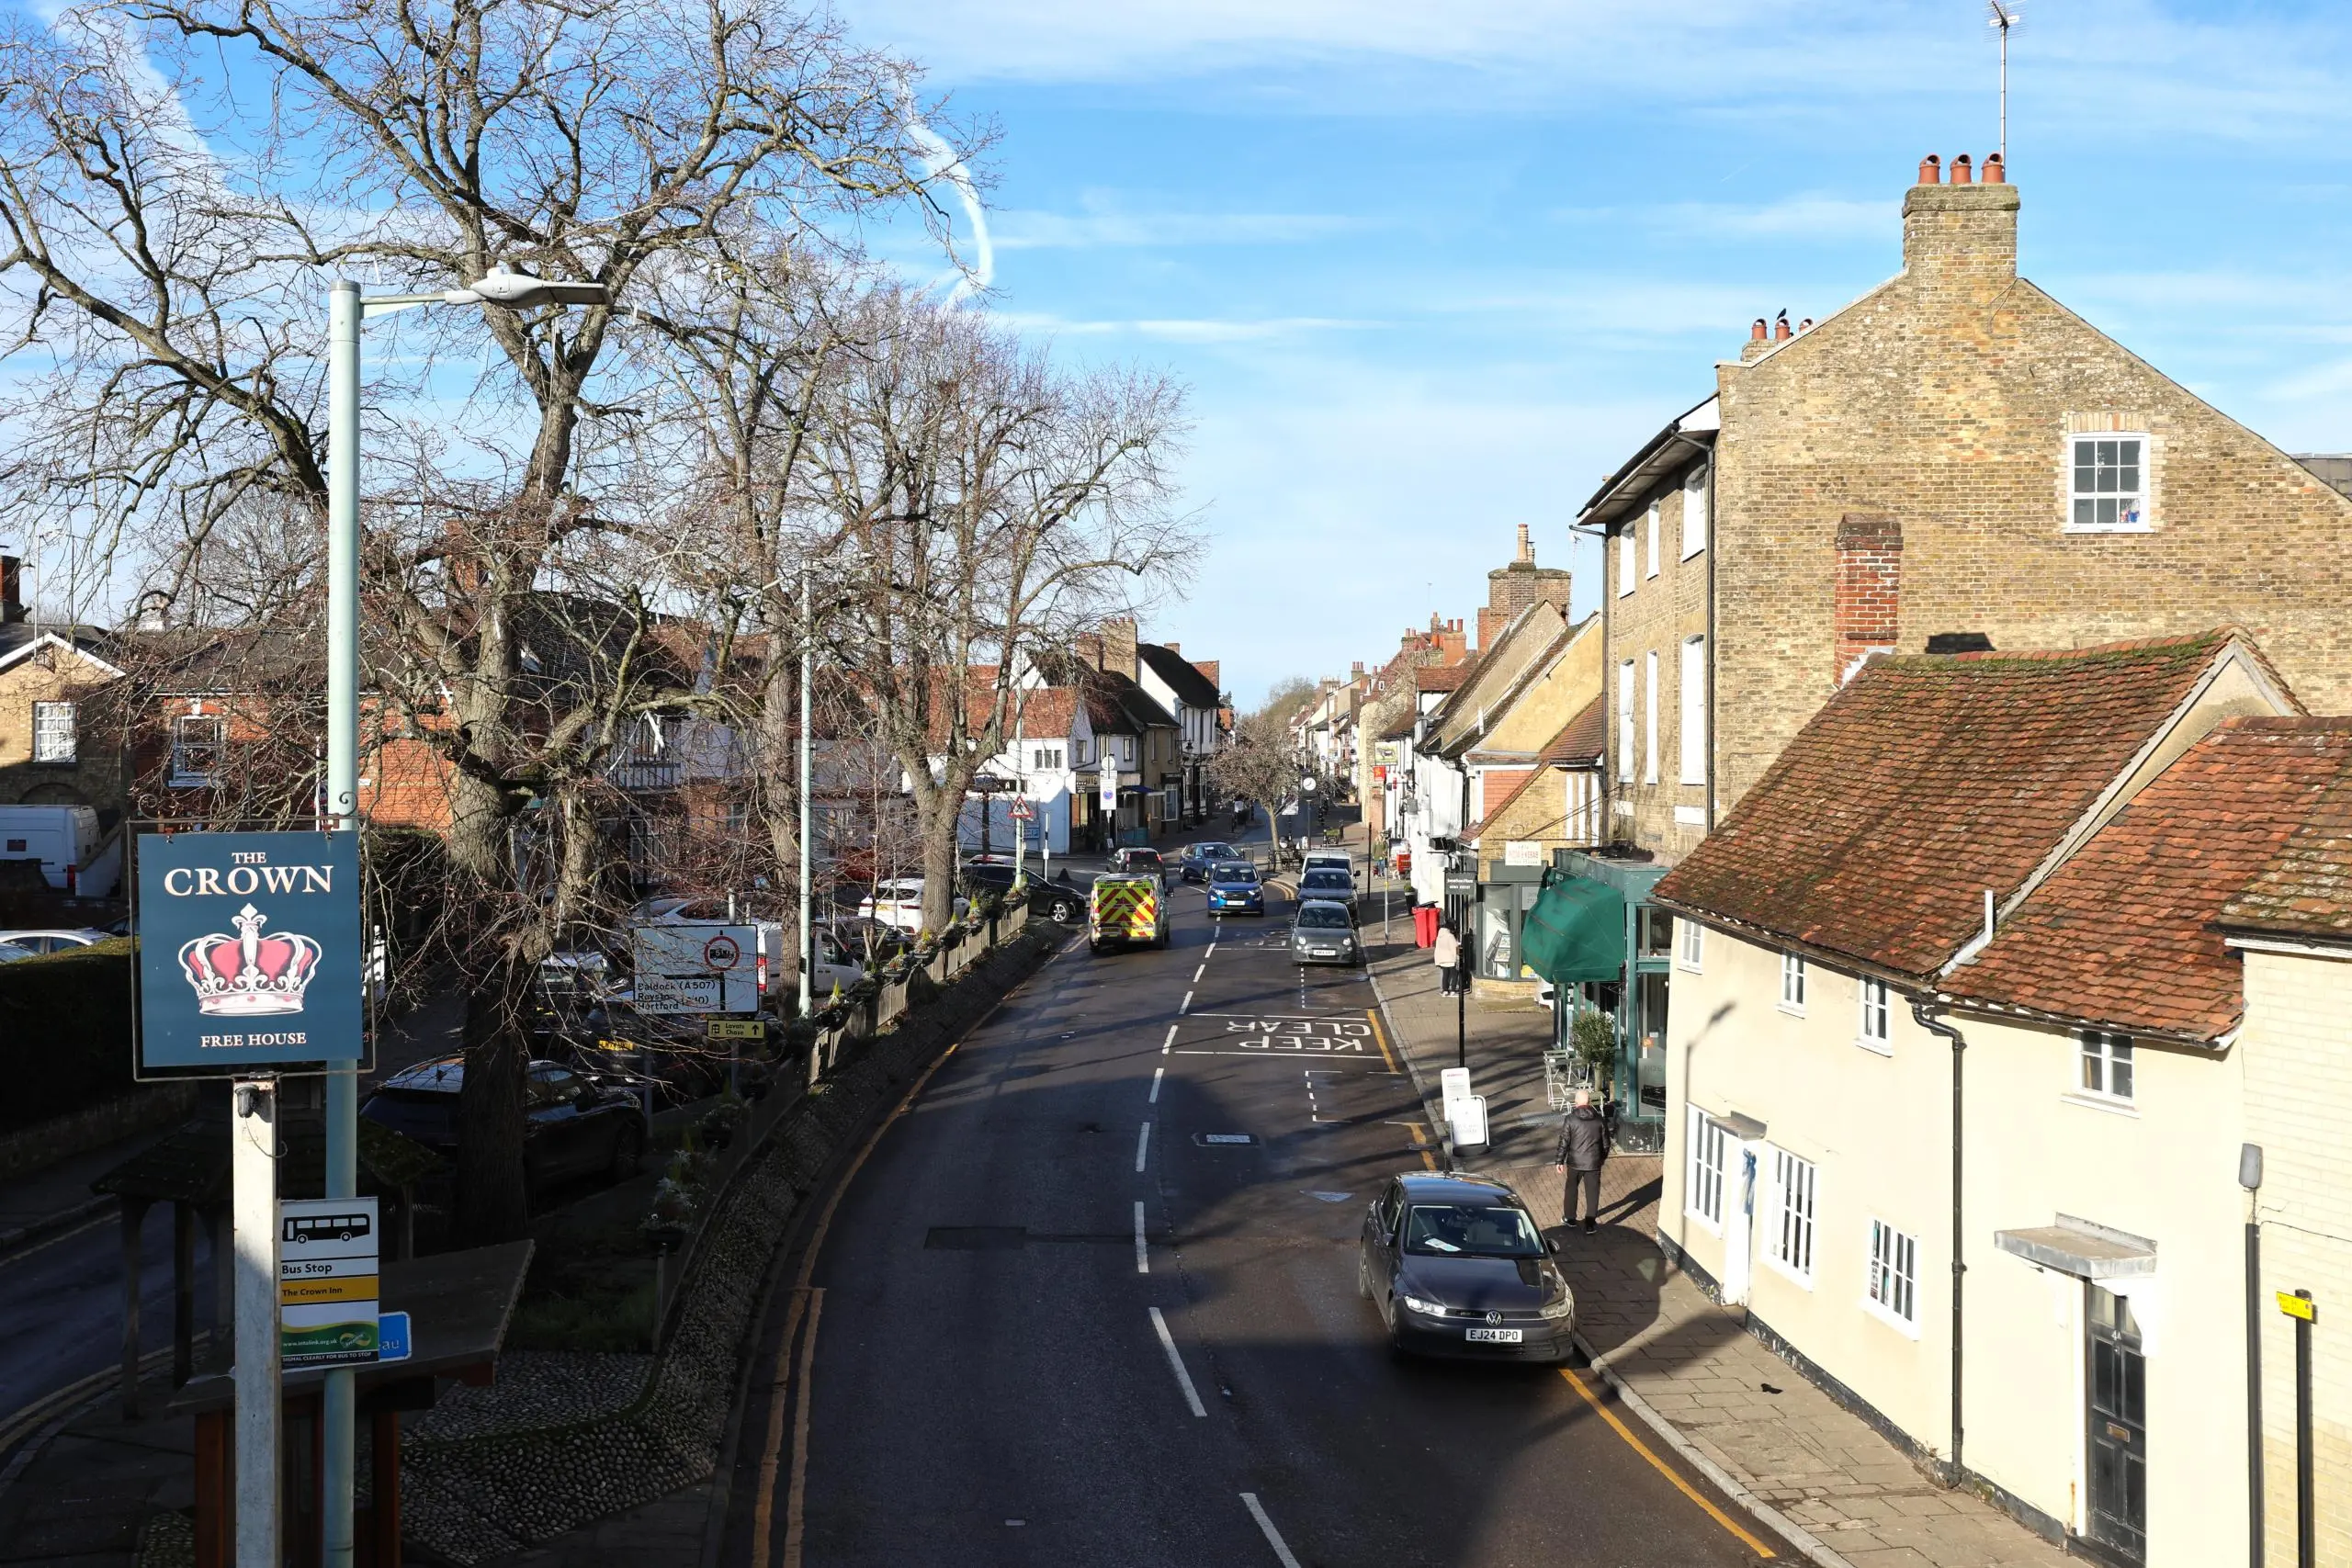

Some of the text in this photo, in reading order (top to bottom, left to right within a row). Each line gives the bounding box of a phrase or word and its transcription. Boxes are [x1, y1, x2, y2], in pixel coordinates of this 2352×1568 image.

[232, 852, 267, 864] THE
[164, 865, 334, 897] CROWN
[1227, 1021, 1371, 1035] CLEAR
[201, 1032, 307, 1047] FREE HOUSE
[1238, 1036, 1363, 1051] KEEP
[282, 1263, 333, 1275] Bus Stop
[282, 1289, 300, 1297] The
[300, 1288, 328, 1296] Crown
[1470, 1330, 1518, 1340] EJ24 DPO
[2111, 1329, 2122, 1340] 4A
